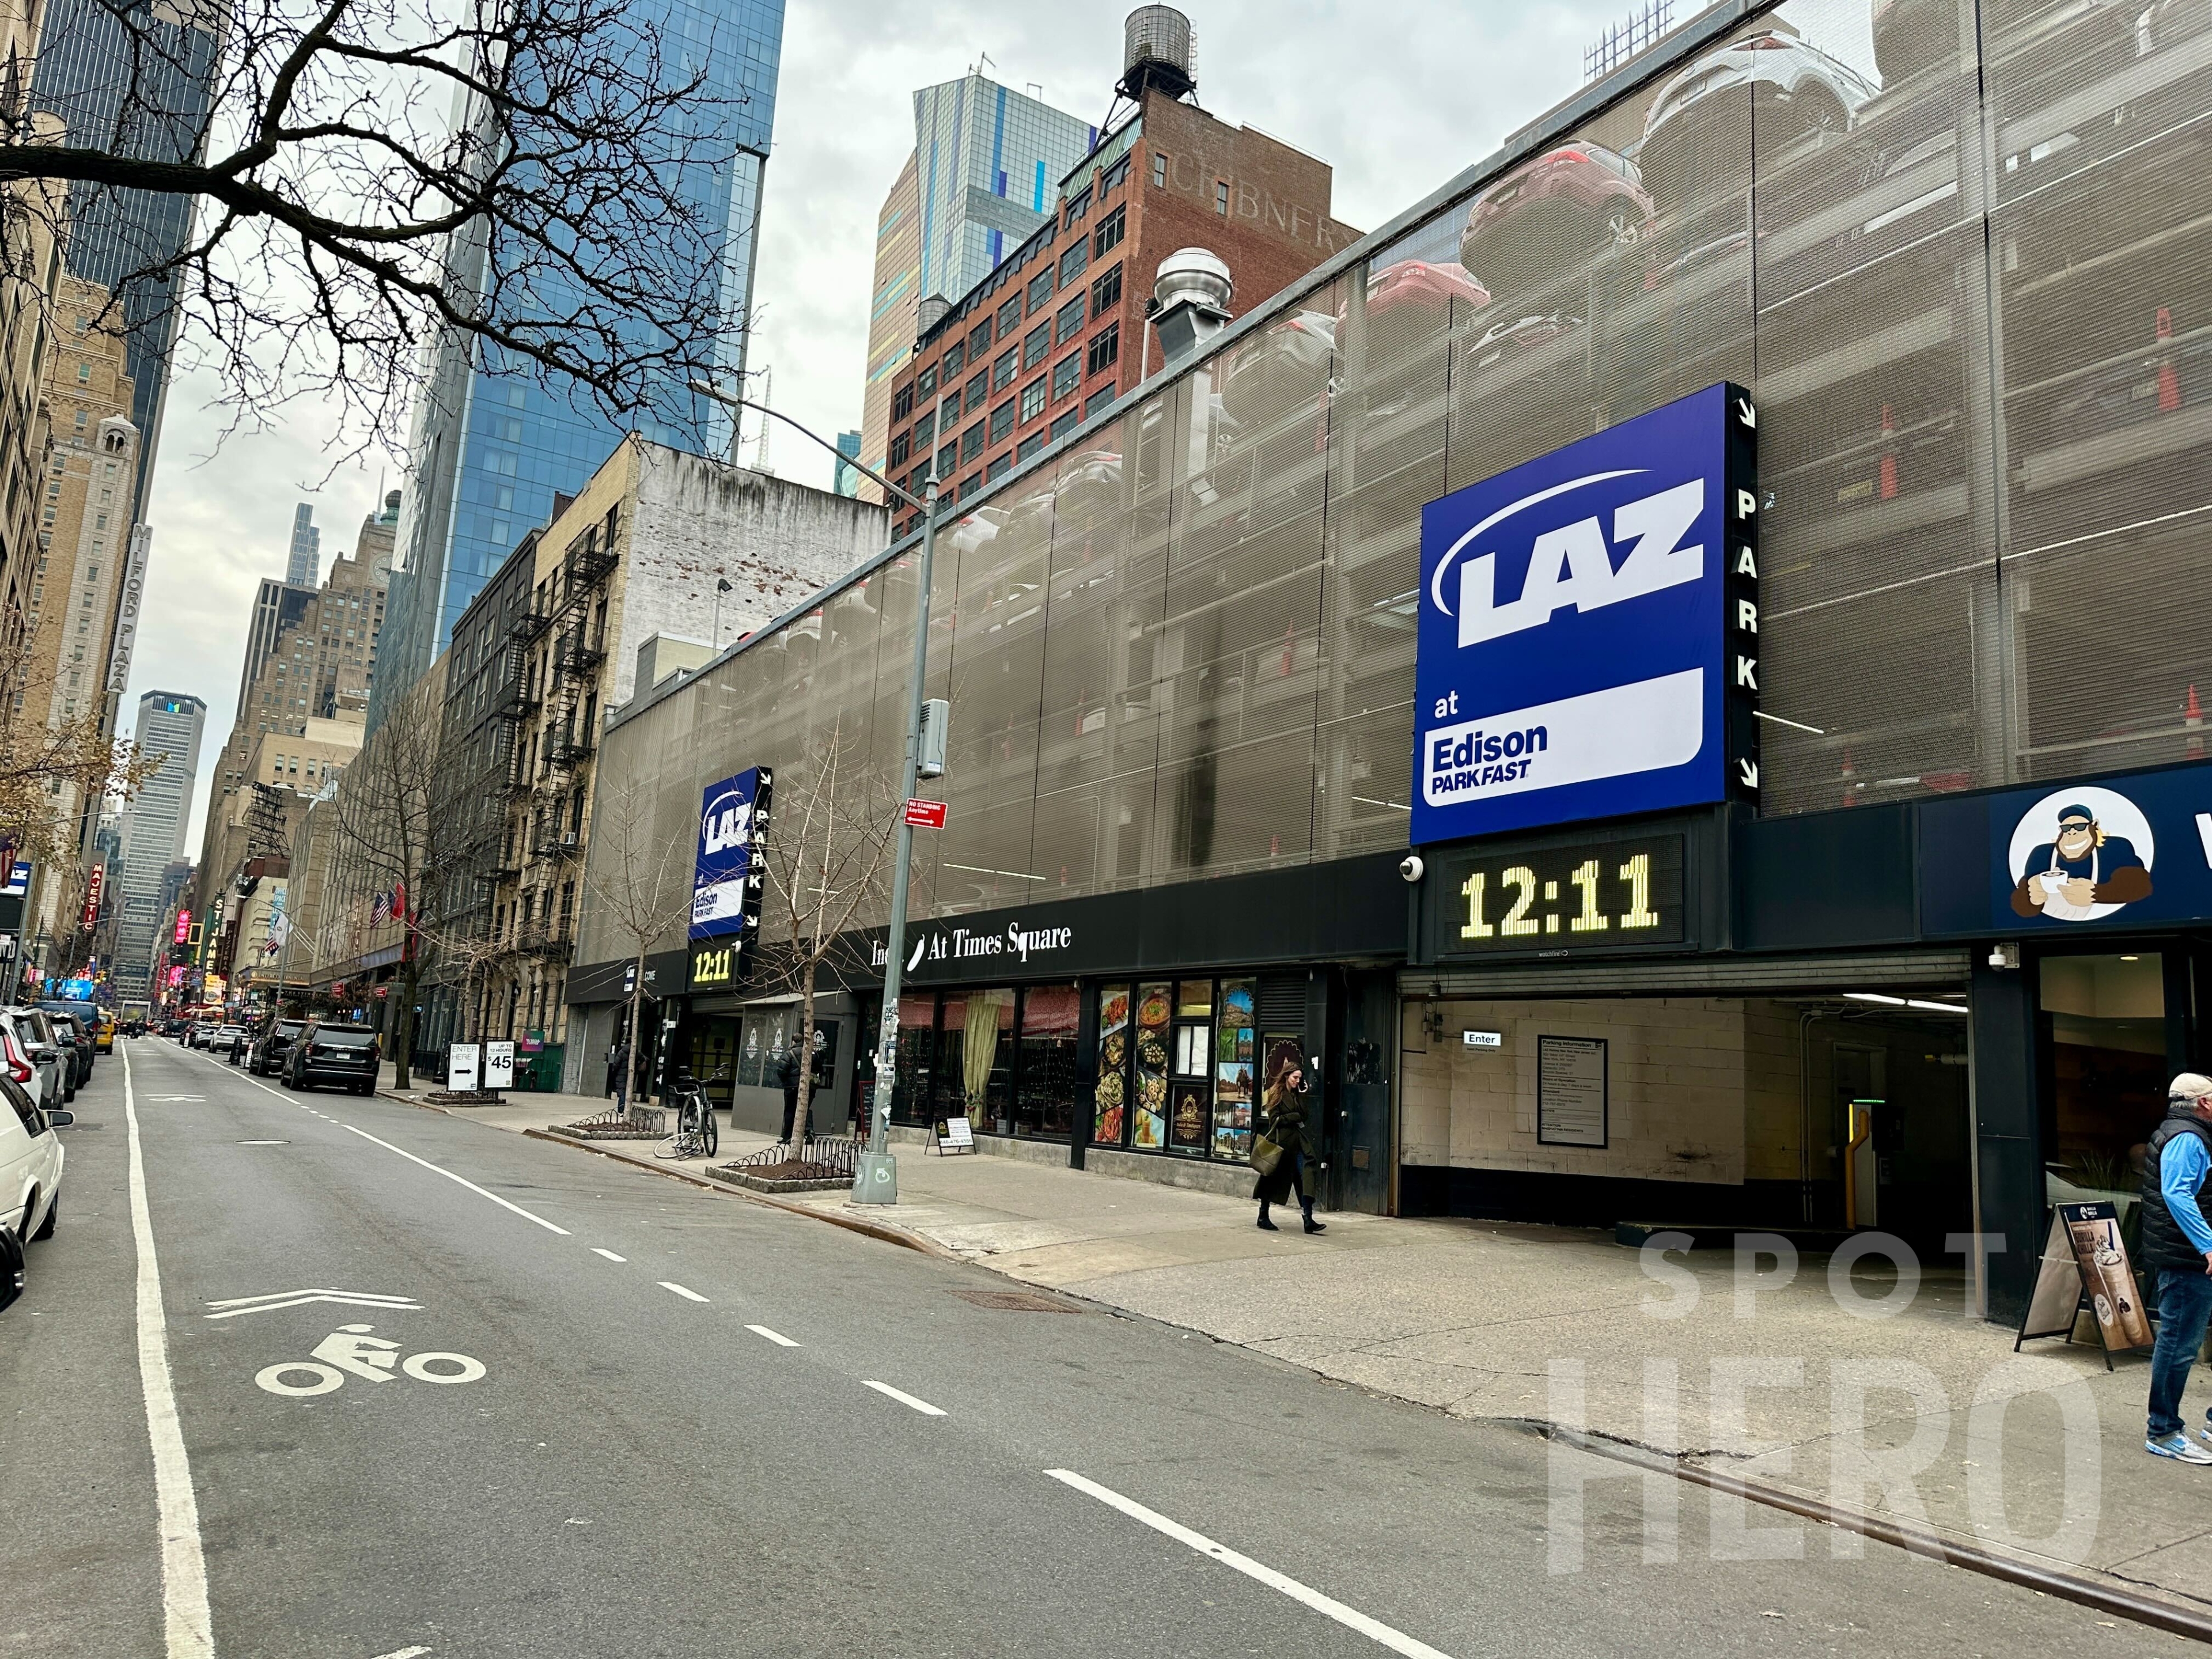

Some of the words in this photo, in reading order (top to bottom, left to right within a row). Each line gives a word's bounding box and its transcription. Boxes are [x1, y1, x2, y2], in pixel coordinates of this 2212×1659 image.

[124, 525, 151, 618] MILFORD
[1458, 478, 1704, 649] LAZ
[1737, 488, 1758, 691] PARK
[109, 624, 133, 691] PLAZA
[1434, 690, 1459, 718] at
[1433, 726, 1547, 772] Edison
[704, 802, 751, 855] LAZ
[908, 806, 929, 815] Anytime
[917, 802, 941, 810] STANDING
[749, 809, 768, 889] PARK
[85, 864, 103, 930] MAJESTIC
[695, 891, 717, 908] Edison
[1460, 854, 1658, 939] 12:11
[694, 949, 730, 982] 12:11
[928, 931, 948, 960] At
[953, 928, 1002, 958] Times
[1007, 922, 1071, 963] Square
[1469, 1034, 1495, 1043] Enter
